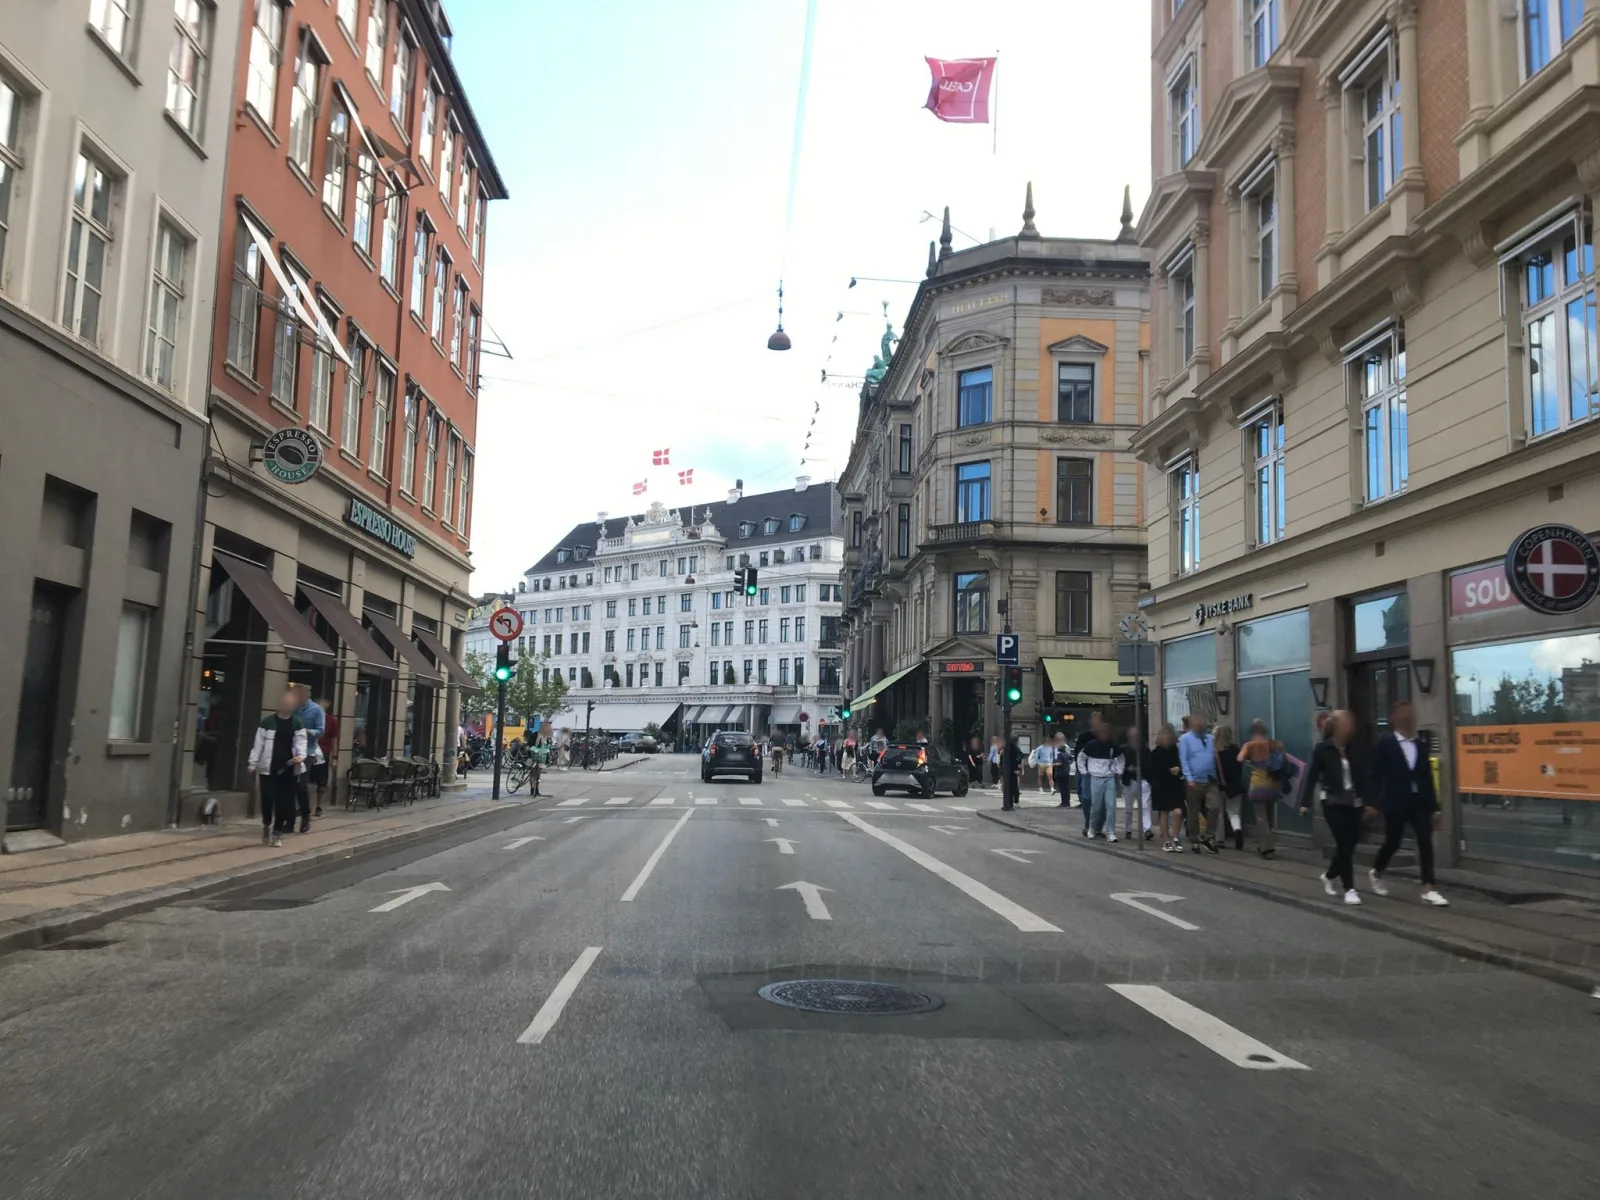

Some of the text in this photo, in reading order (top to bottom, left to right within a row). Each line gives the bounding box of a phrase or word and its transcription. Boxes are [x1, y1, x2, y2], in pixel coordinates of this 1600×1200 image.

[268, 430, 316, 452] ESPRESSO
[271, 465, 309, 480] HOUSE
[350, 498, 416, 557] ESPRESSO HOUSE
[1519, 527, 1594, 560] COPENHAGEN
[1204, 594, 1252, 618] JYSKE BANK
[1001, 636, 1014, 654] P
